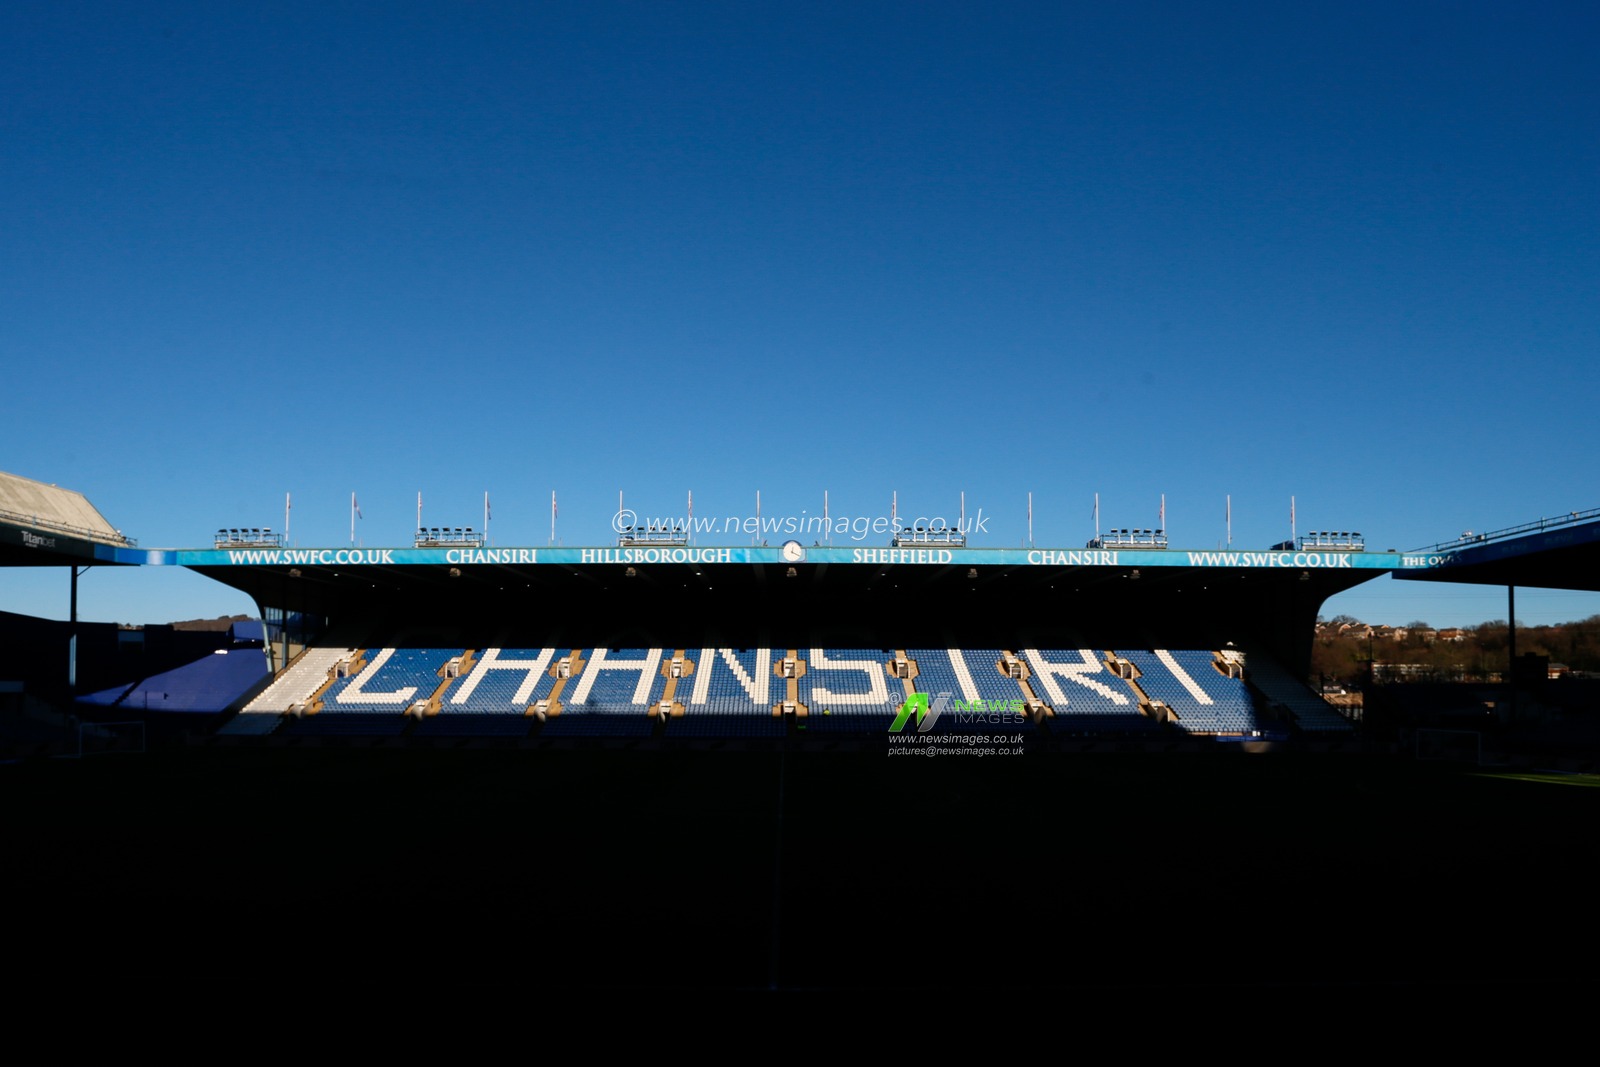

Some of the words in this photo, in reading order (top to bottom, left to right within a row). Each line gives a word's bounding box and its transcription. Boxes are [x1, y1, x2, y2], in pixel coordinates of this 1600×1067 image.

[228, 549, 394, 565] WWW.SWFC.CO.UK
[446, 549, 537, 564] CHANSIRI
[581, 549, 731, 564] HILLSBOROUGH
[853, 549, 952, 564] SHEFFIELD
[1027, 550, 1119, 566] CHANSIRI
[1187, 552, 1351, 568] WWW.SWFC.CO.UK
[1402, 556, 1426, 567] THE
